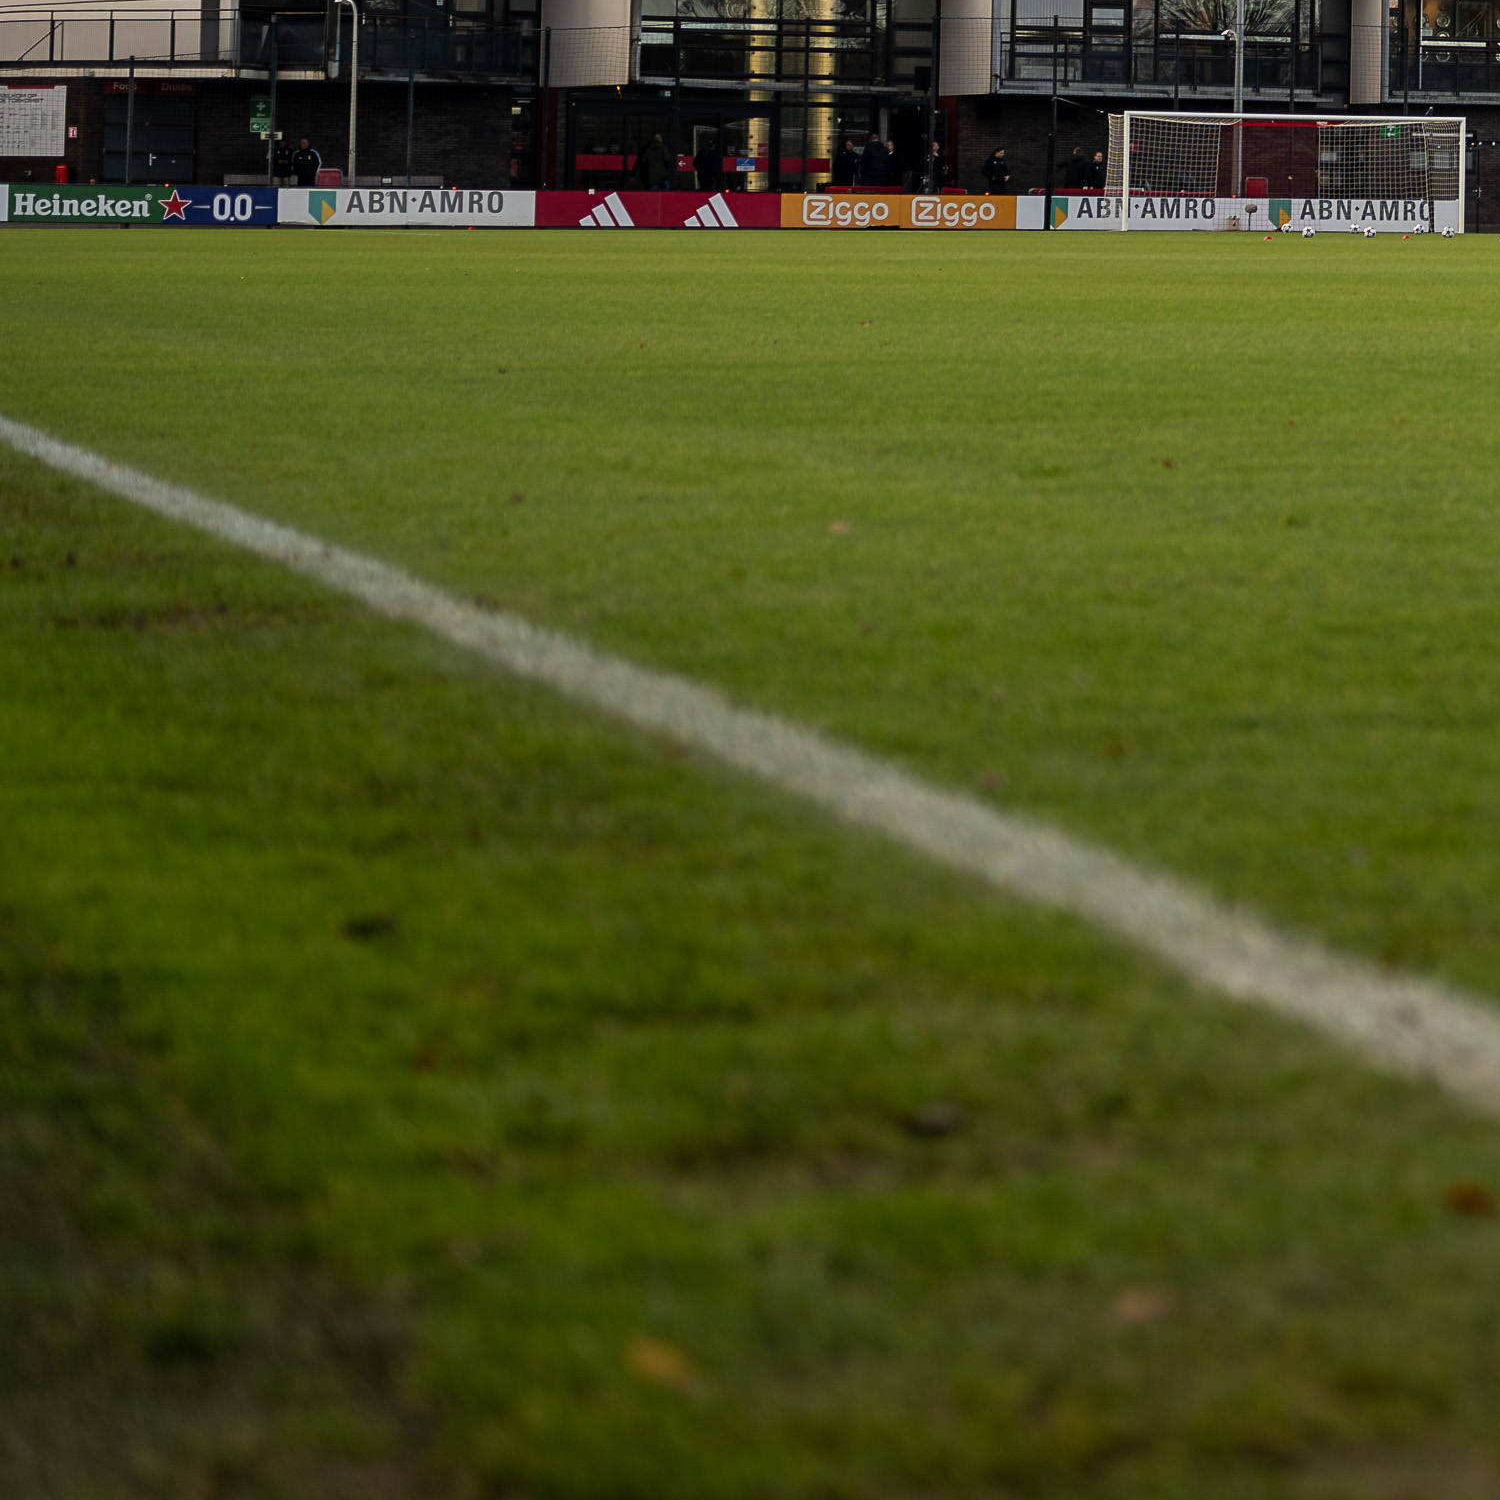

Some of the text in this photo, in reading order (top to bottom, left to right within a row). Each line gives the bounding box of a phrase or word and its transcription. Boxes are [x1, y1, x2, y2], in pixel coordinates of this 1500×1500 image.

[13, 193, 151, 217] Heineken
[212, 193, 252, 221] 0.0
[346, 190, 504, 214] ABN AMRO
[1076, 198, 1216, 219] ABN AMRO
[1300, 199, 1351, 220] ABN
